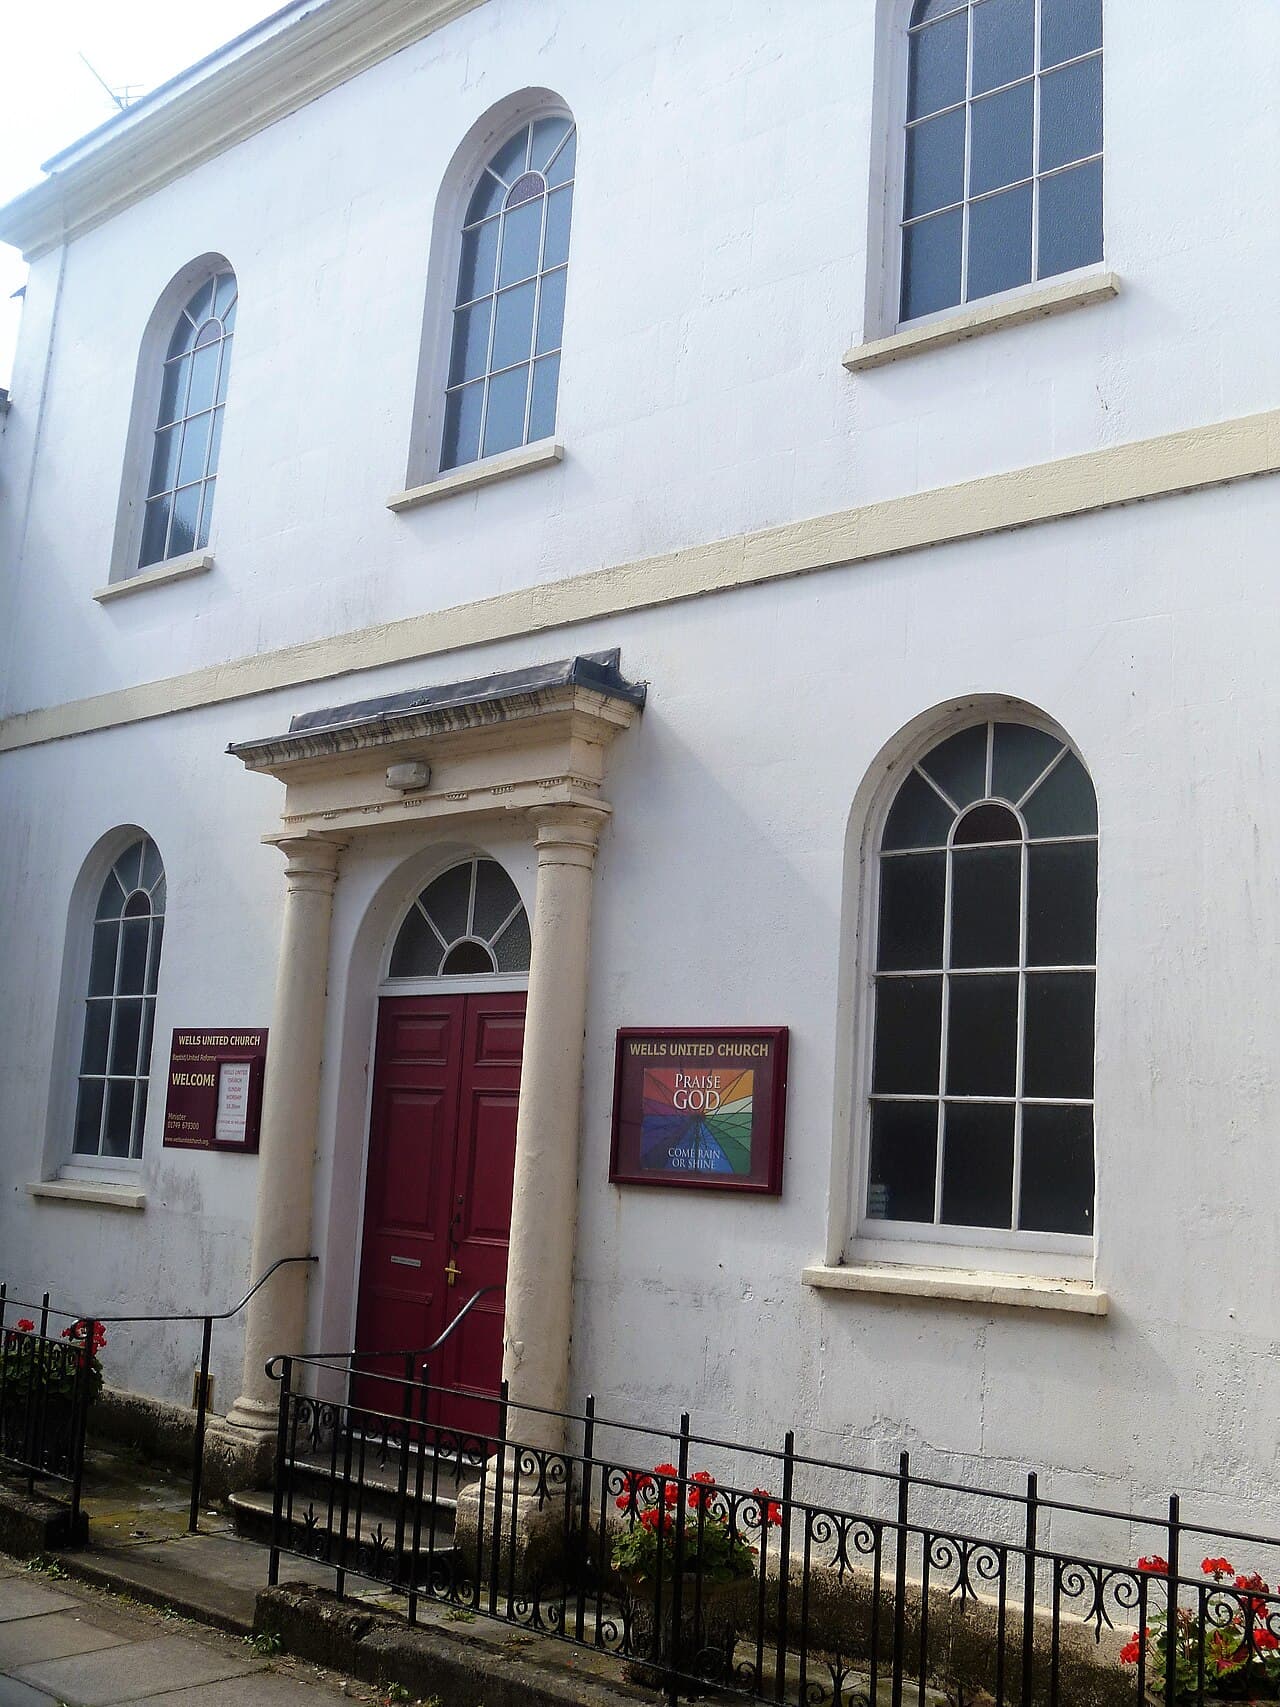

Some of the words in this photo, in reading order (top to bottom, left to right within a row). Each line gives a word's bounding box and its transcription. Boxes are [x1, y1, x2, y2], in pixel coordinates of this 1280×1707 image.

[179, 1035, 201, 1046] WELLS
[202, 1035, 229, 1046] UNITED
[230, 1035, 260, 1046] CHURCH
[630, 1043, 667, 1056] WELLS
[669, 1043, 715, 1056] UNITED
[717, 1043, 769, 1057] CHURCH
[172, 1073, 215, 1086] WELCOME
[675, 1073, 720, 1089] PRAISE
[673, 1089, 720, 1110] GOD
[668, 1147, 696, 1158] COME
[698, 1149, 720, 1159] RAIN
[672, 1158, 686, 1168] OR
[688, 1159, 716, 1169] SHINE
